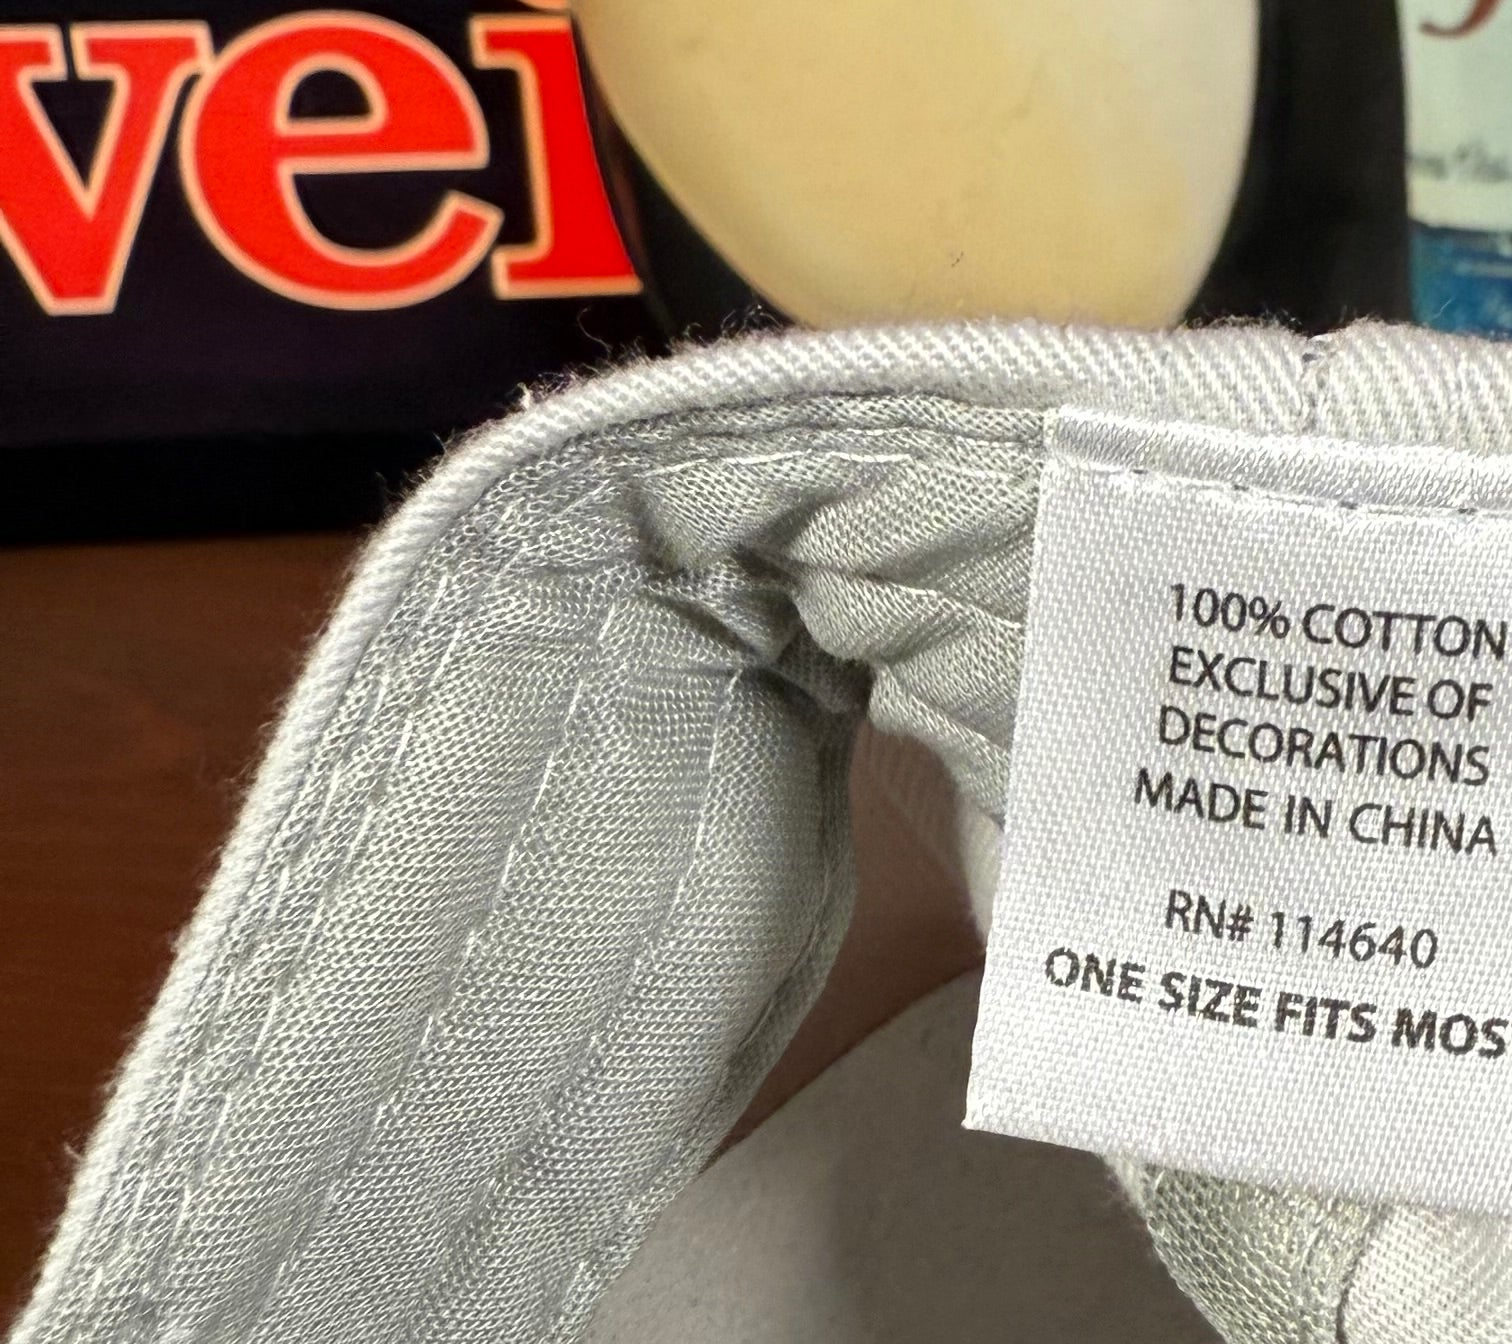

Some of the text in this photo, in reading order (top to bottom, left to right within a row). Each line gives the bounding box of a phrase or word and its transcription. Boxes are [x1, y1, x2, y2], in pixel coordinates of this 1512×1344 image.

[1173, 584, 1506, 660] 100% COTTON
[1170, 646, 1492, 721] EXCLUSIVE OF
[1159, 706, 1488, 785] DECORATIONS
[1135, 769, 1495, 854] MADE IN CHINA
[1166, 891, 1436, 967] RN# 114640
[1047, 949, 1143, 1001] ONE
[1160, 973, 1260, 1026] SIZE
[1276, 993, 1375, 1042] FITS
